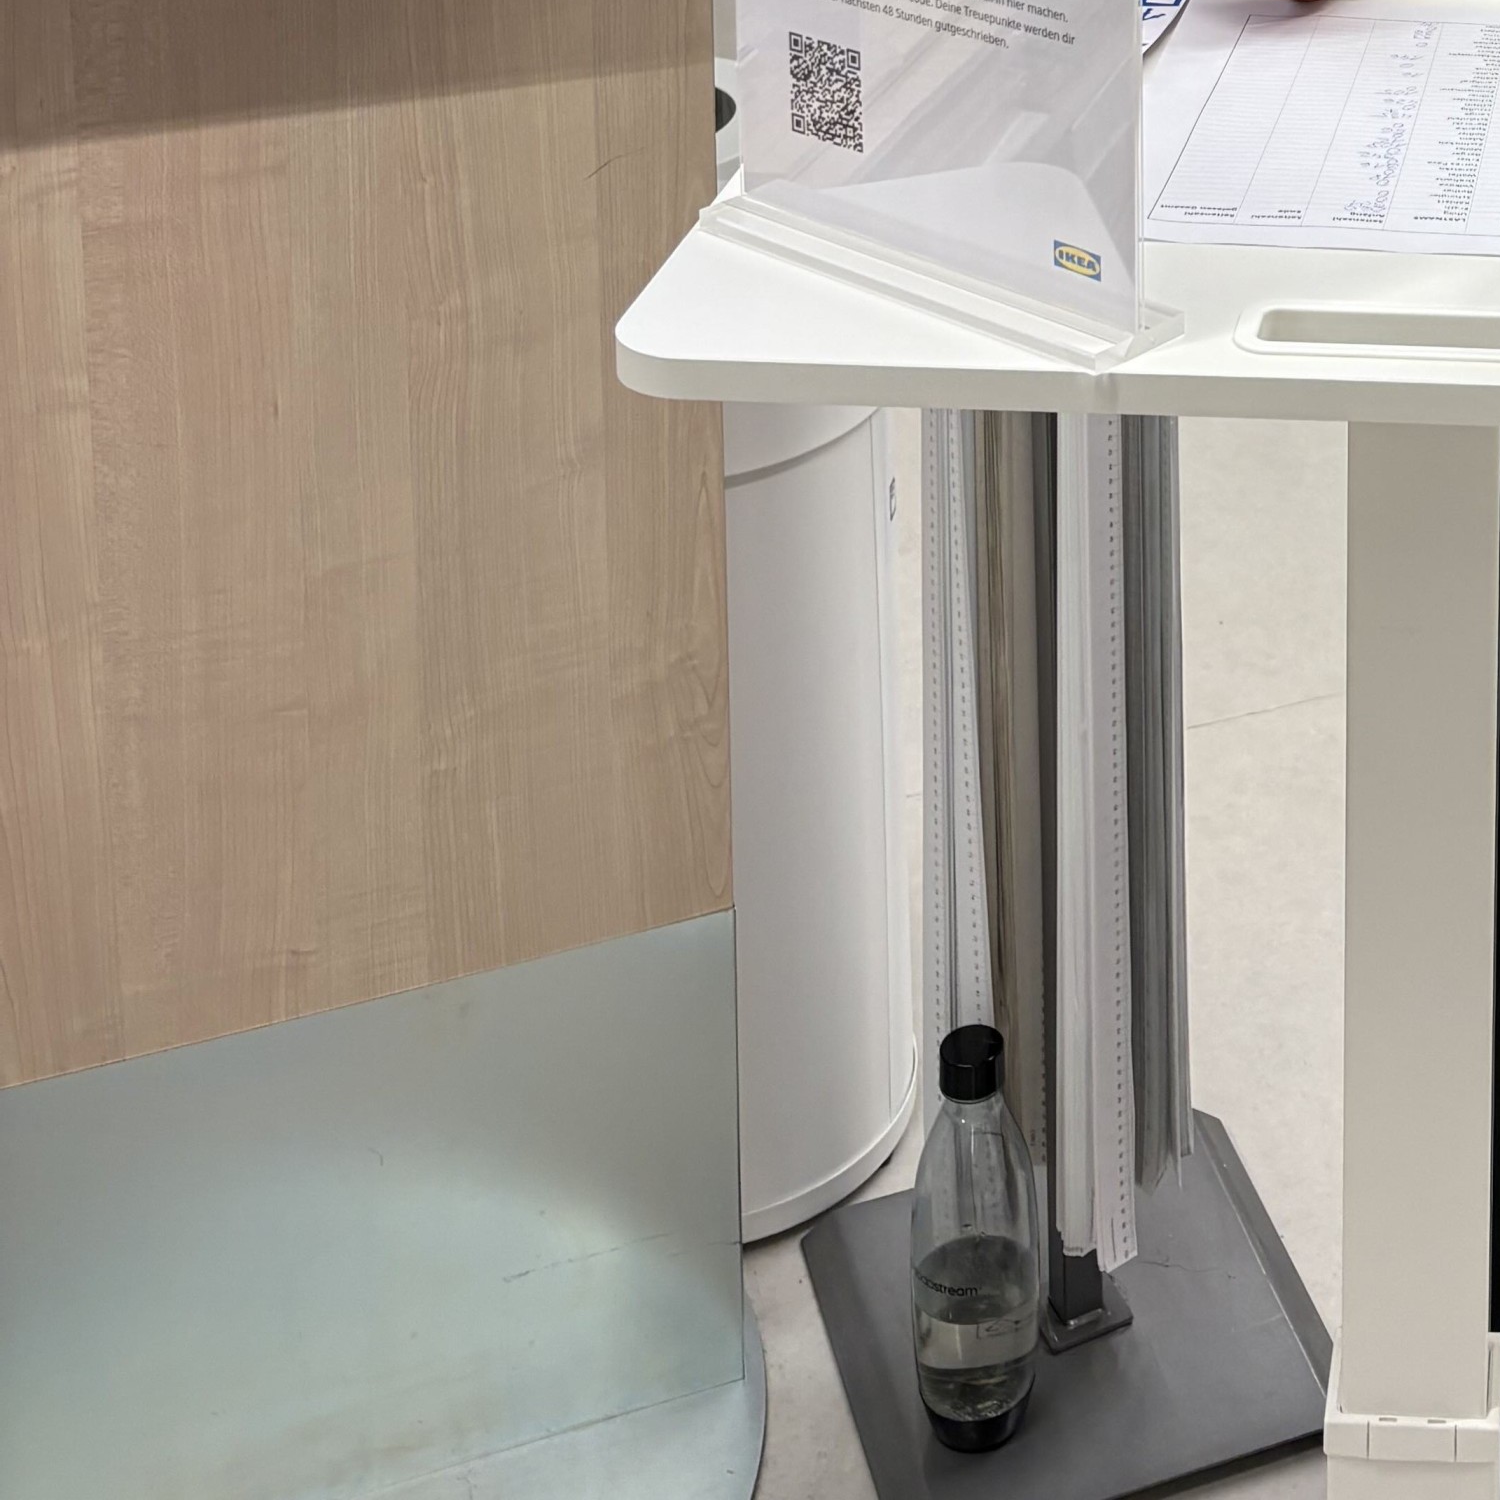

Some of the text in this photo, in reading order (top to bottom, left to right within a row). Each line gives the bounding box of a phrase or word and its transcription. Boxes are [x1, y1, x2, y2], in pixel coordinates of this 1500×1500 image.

[882, 4, 894, 17] 48
[895, 8, 933, 28] Stunden
[934, 19, 1010, 49] gutgeschrieben.
[963, 5, 1022, 31] Treuepunkte
[1023, 23, 1060, 42] werden
[1061, 32, 1076, 45] dir
[1027, 3, 1069, 23] machen.
[1058, 249, 1097, 273] IKEA
